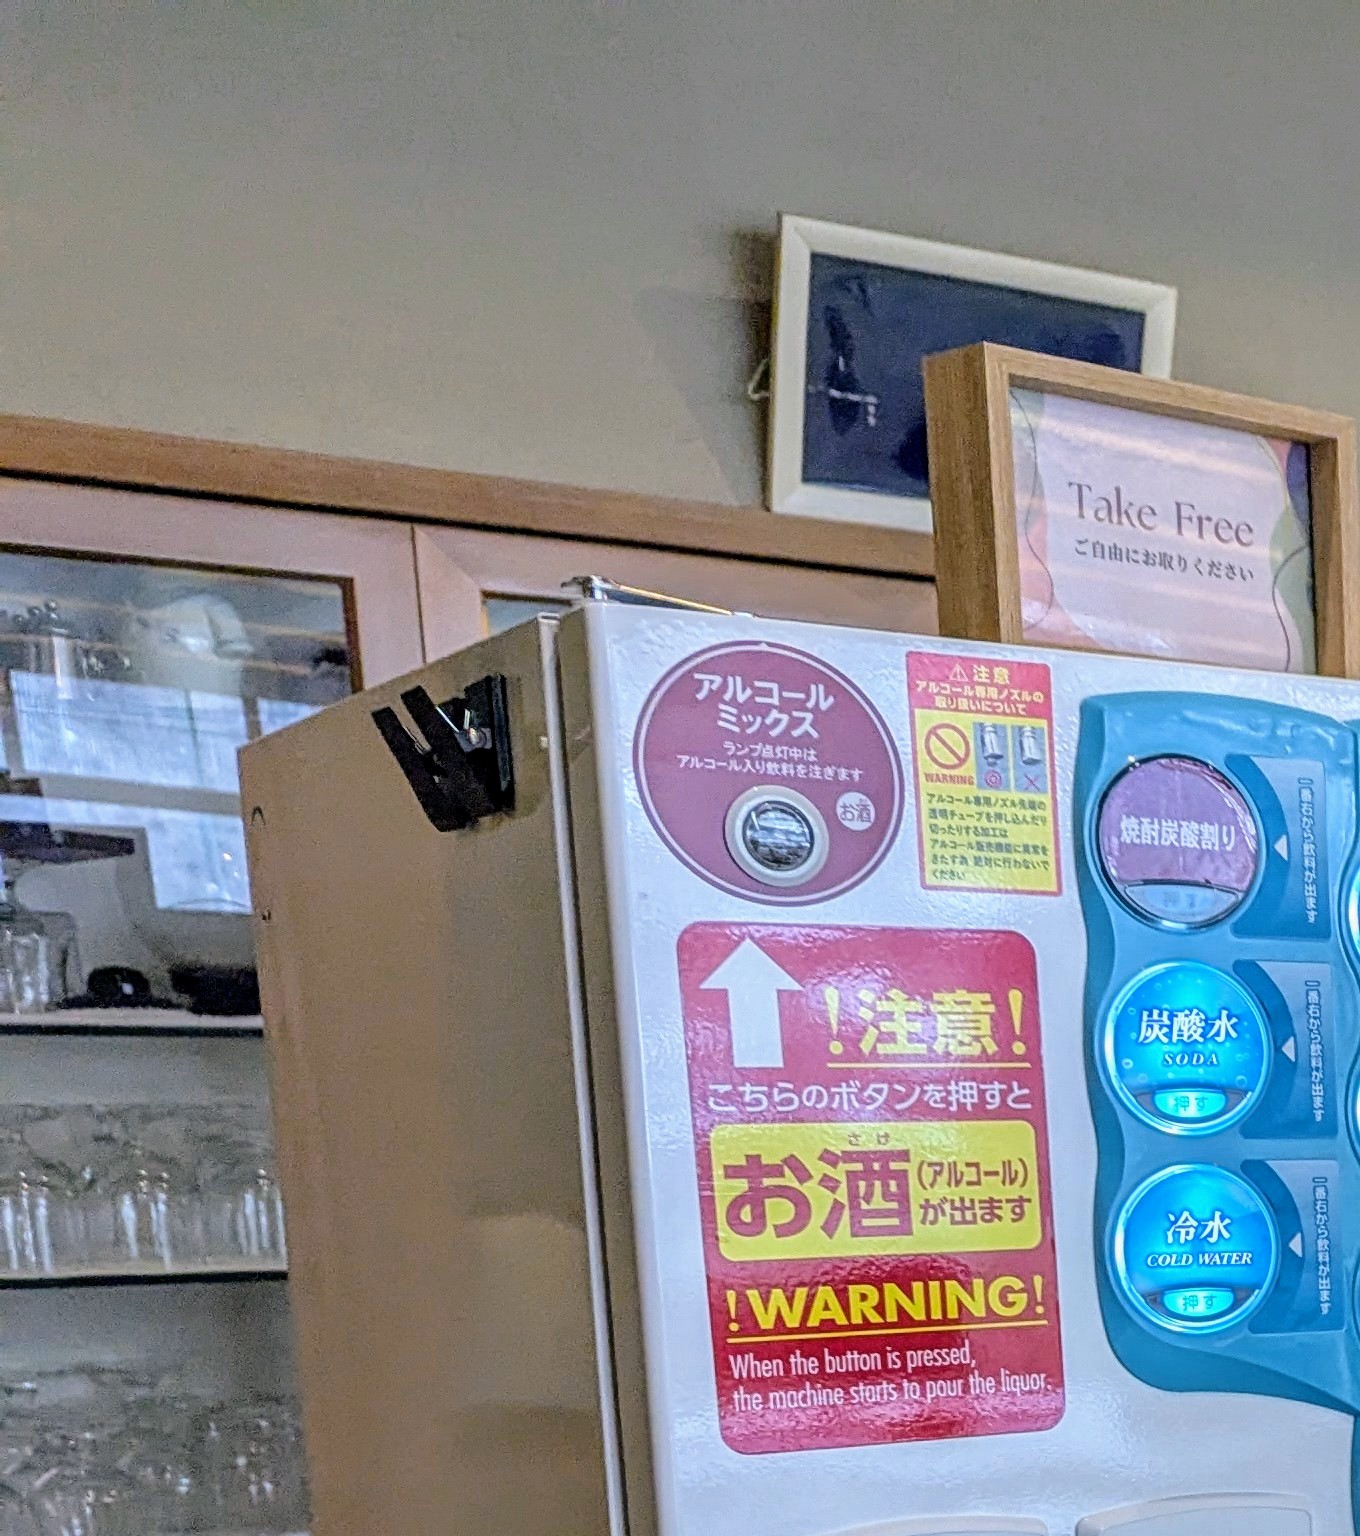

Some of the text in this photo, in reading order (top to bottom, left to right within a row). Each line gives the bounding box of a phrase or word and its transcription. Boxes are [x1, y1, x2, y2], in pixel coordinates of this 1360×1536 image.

[1068, 481, 1254, 547] Take Free
[1075, 537, 1255, 582] ご自由にお取りください
[973, 664, 1010, 684] 注意
[693, 673, 835, 712] アルコール
[915, 680, 1044, 703] アルコール専用ノズルの
[935, 695, 1027, 715] 取り扱いについて
[716, 703, 819, 738] ミックス
[722, 740, 818, 763] ランプ点灯中は
[676, 754, 864, 782] アルコール入り飲料を注ぎます
[924, 772, 974, 786] WARNING
[838, 799, 872, 825] お酒
[1120, 815, 1235, 851] 焼酎炭酸割り
[1138, 1009, 1239, 1044] 炭酸水
[1164, 1053, 1219, 1065] SODA
[708, 1080, 1032, 1112] こちらのボタンを押すと
[1173, 1095, 1209, 1111] 押す
[723, 1148, 913, 1240] お酒
[919, 1195, 1032, 1227] が出ます
[1166, 1211, 1232, 1244] 冷水
[1147, 1252, 1252, 1267] COLD WATER
[1183, 1295, 1217, 1311] 押す
[729, 1341, 976, 1380] When the button is pressed,
[732, 1370, 1052, 1411] the machine starts to pour the liquor.
